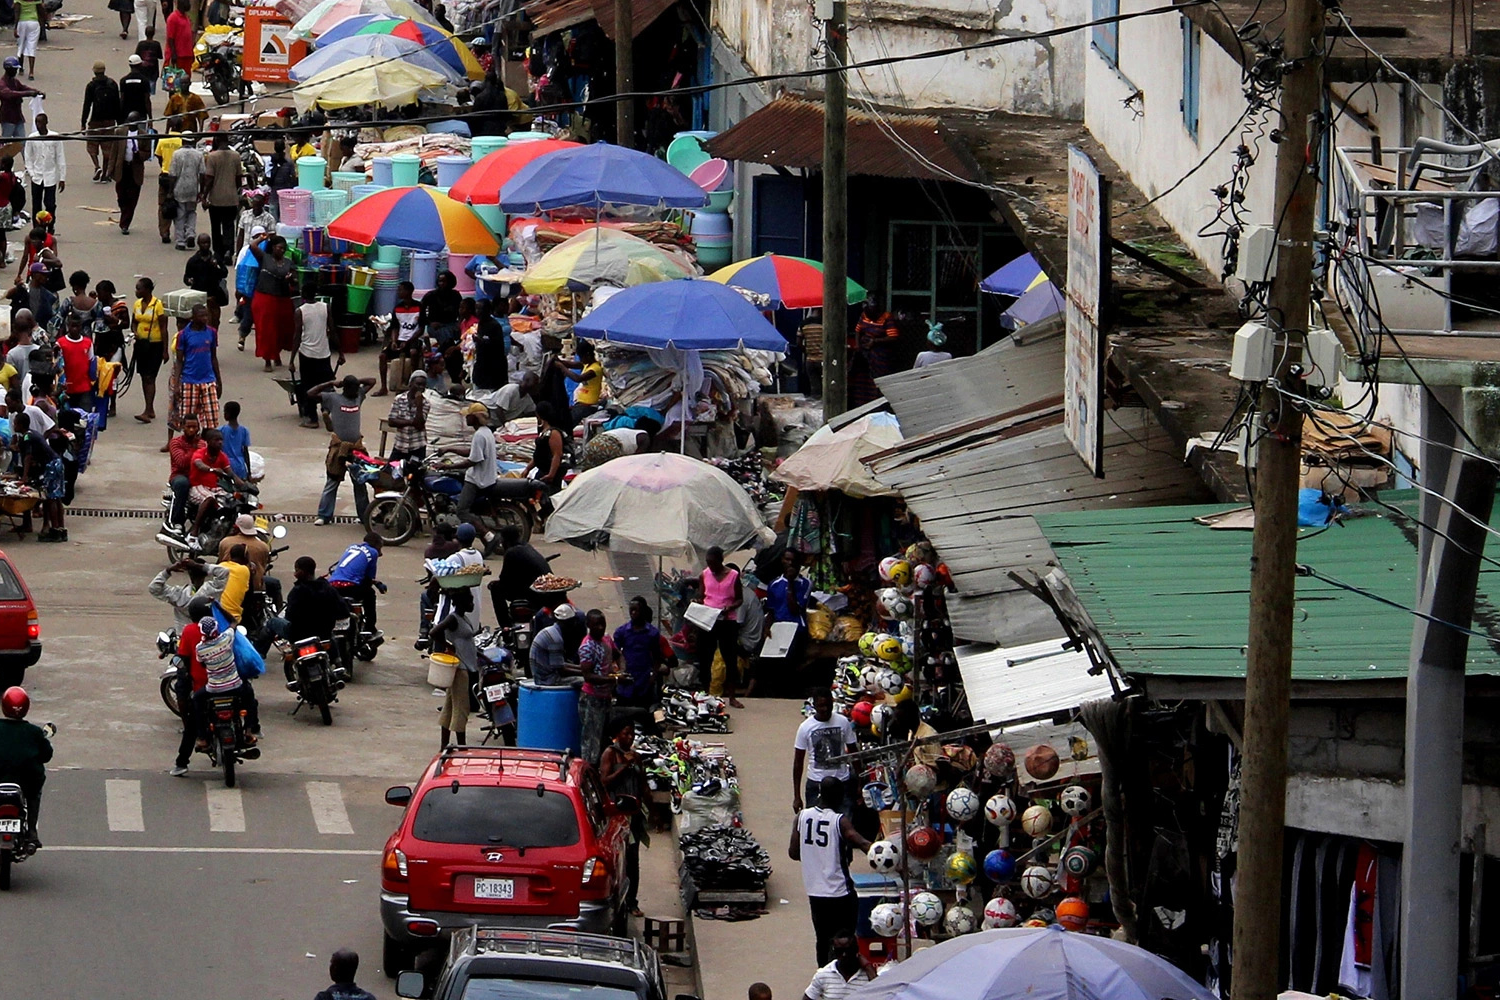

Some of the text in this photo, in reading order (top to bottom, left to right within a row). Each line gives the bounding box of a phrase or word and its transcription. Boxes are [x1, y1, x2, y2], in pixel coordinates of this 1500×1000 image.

[248, 9, 274, 17] DIPLOMAT
[339, 549, 361, 567] 7
[804, 818, 830, 847] 15
[476, 883, 512, 894] PC-18343
